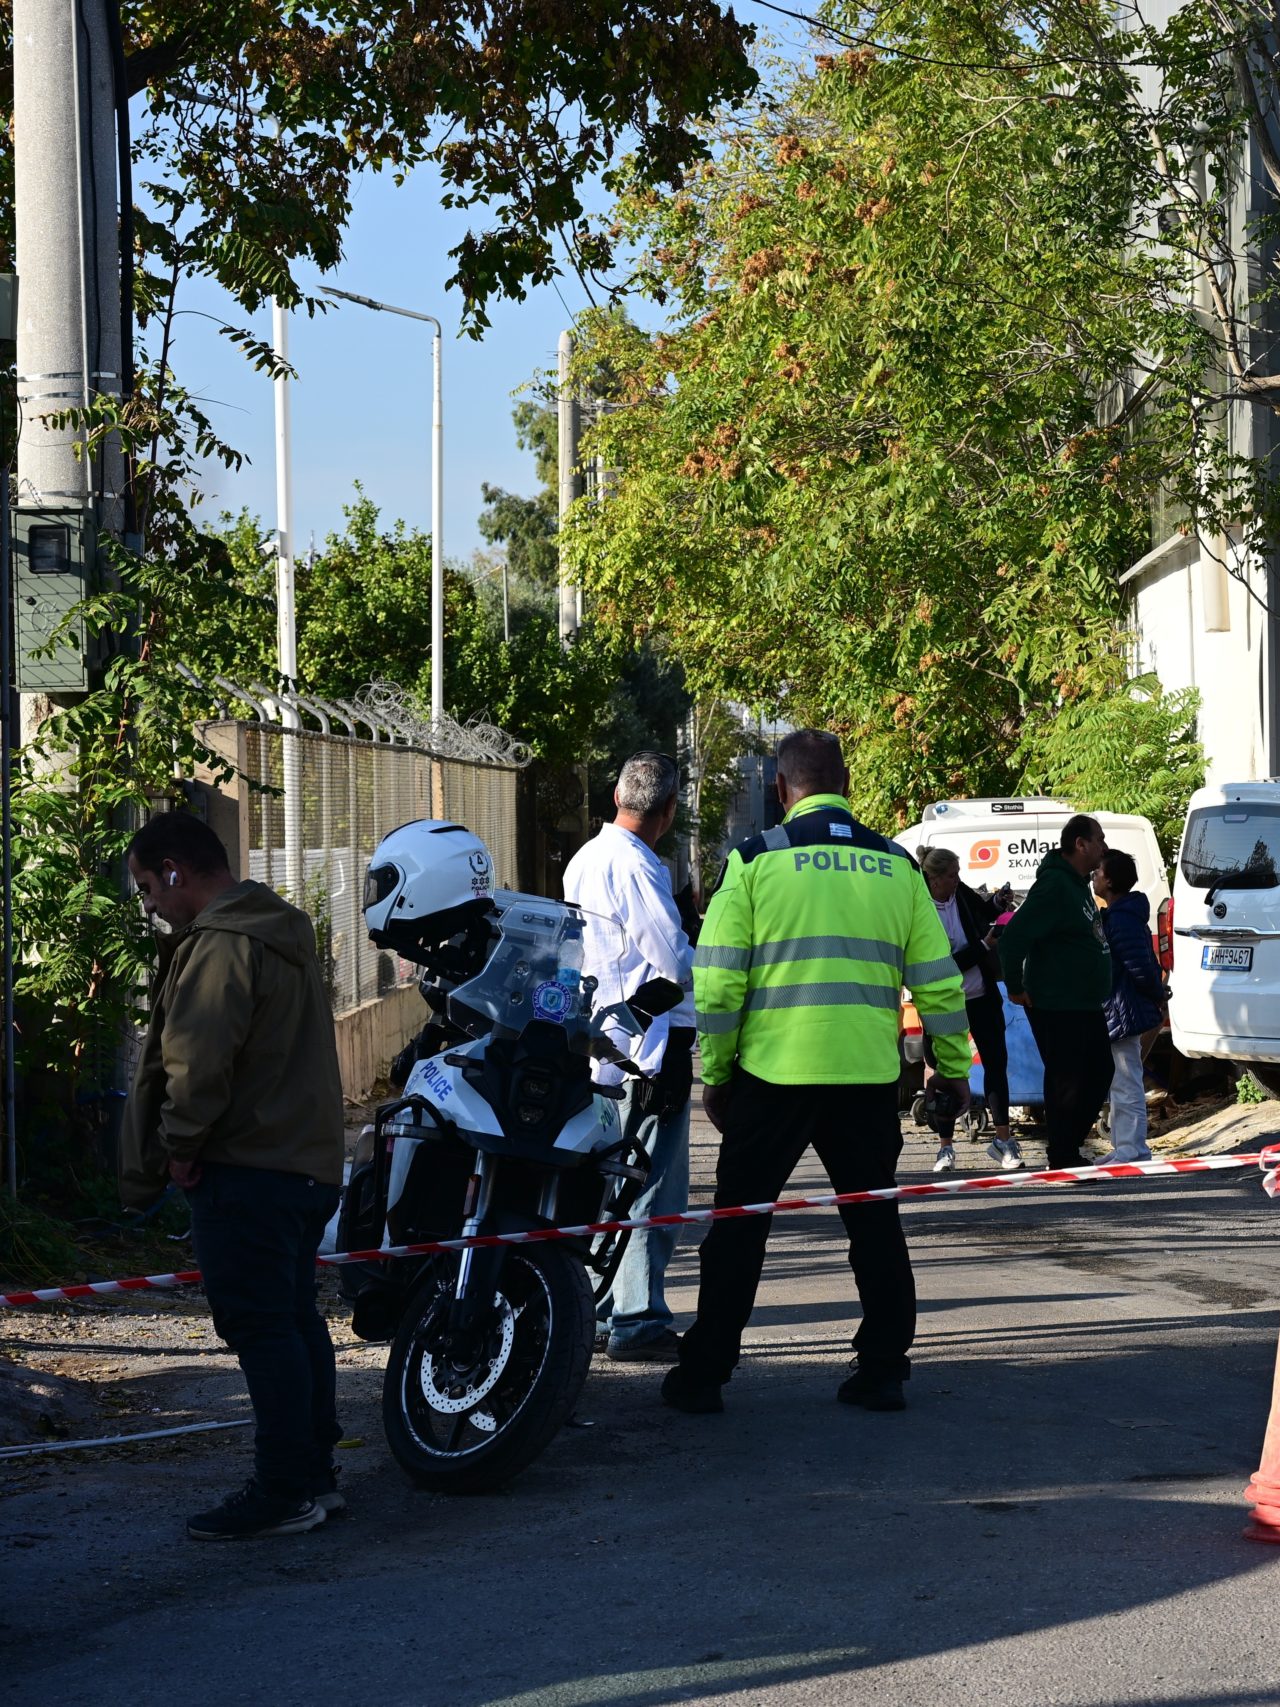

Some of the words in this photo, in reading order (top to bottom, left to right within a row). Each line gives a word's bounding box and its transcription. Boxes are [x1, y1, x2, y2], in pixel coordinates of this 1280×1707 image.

[1007, 838, 1060, 855] eMar
[793, 850, 893, 878] POLICE
[419, 1060, 453, 1102] POLICE
